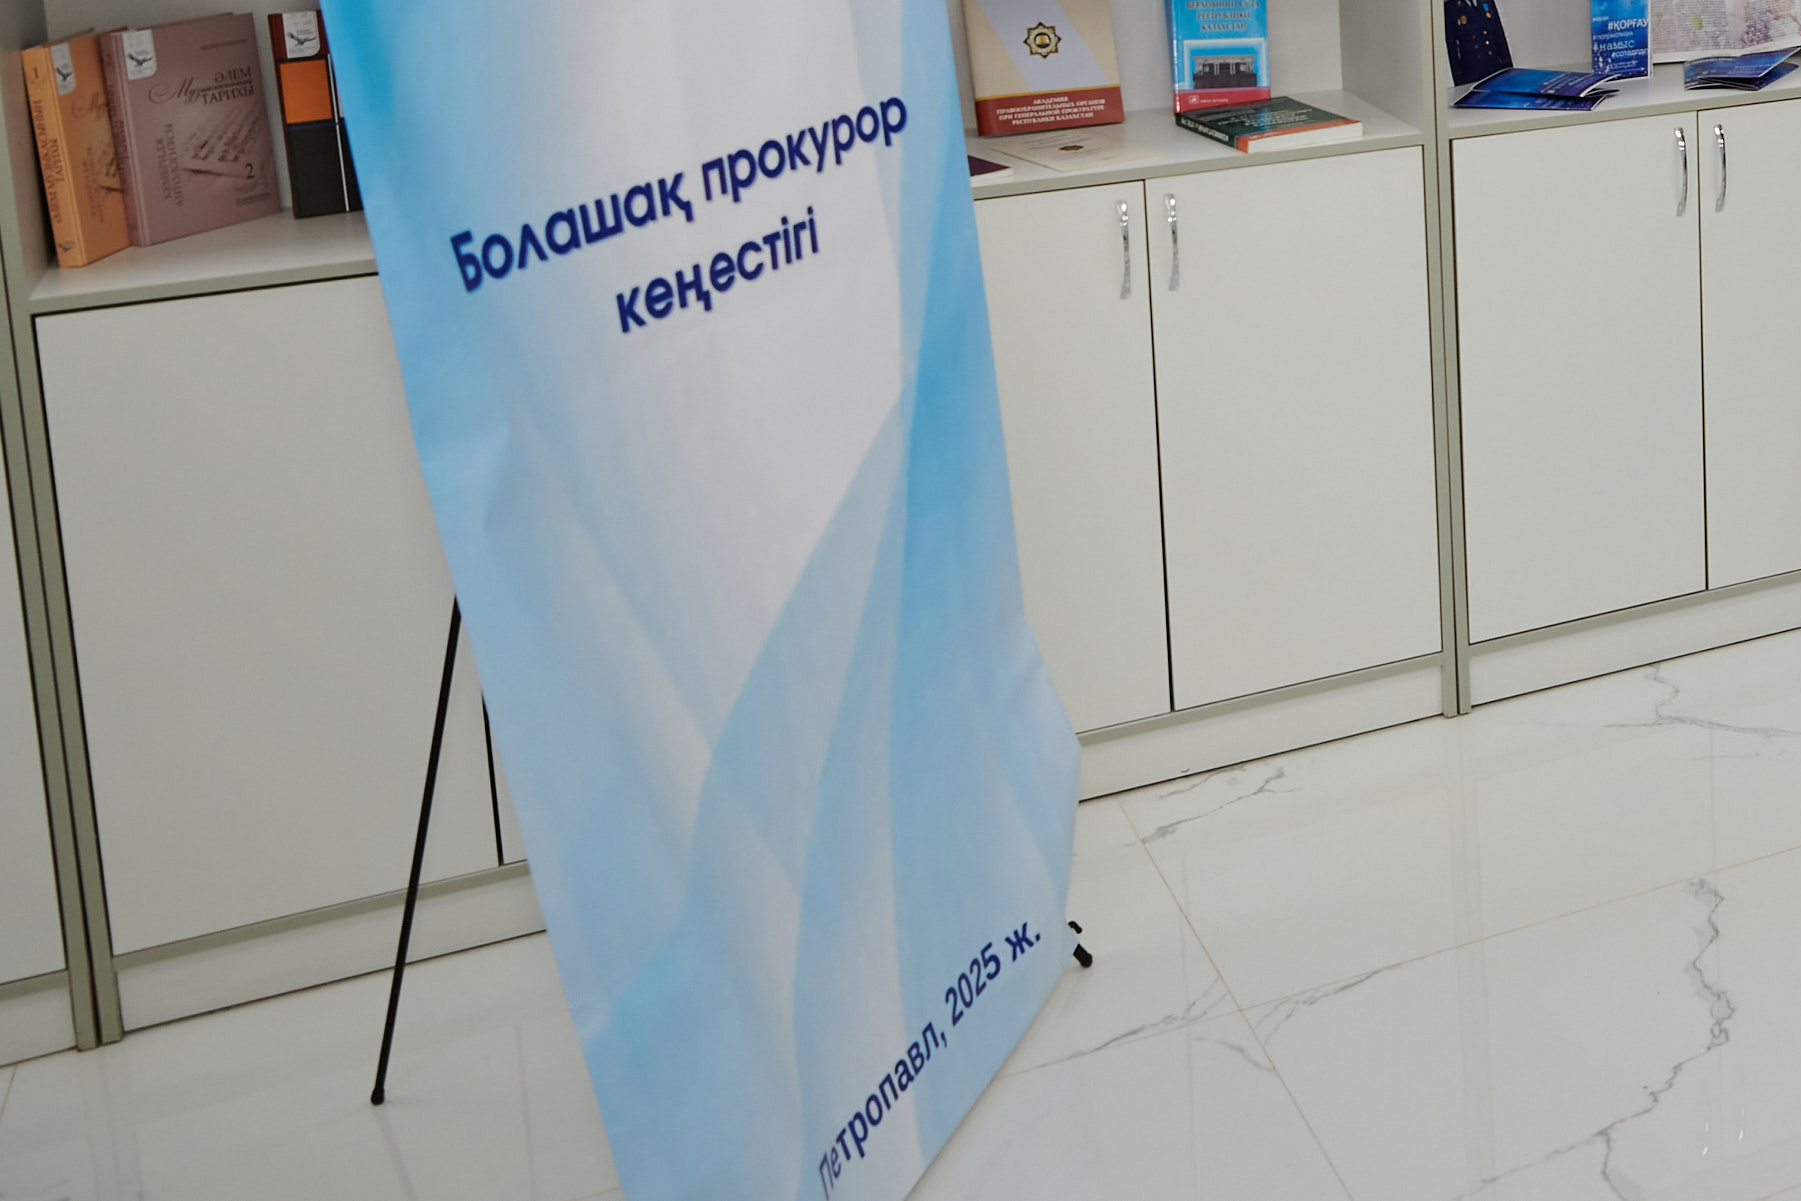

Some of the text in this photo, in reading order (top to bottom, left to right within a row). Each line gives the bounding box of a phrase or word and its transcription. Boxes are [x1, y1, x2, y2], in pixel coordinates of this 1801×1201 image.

[245, 162, 255, 179] 2
[450, 97, 908, 292] Болашақ прокурор
[616, 206, 819, 333] кеңестігі
[819, 921, 1042, 1201] Петропавл, 2025 ж.
